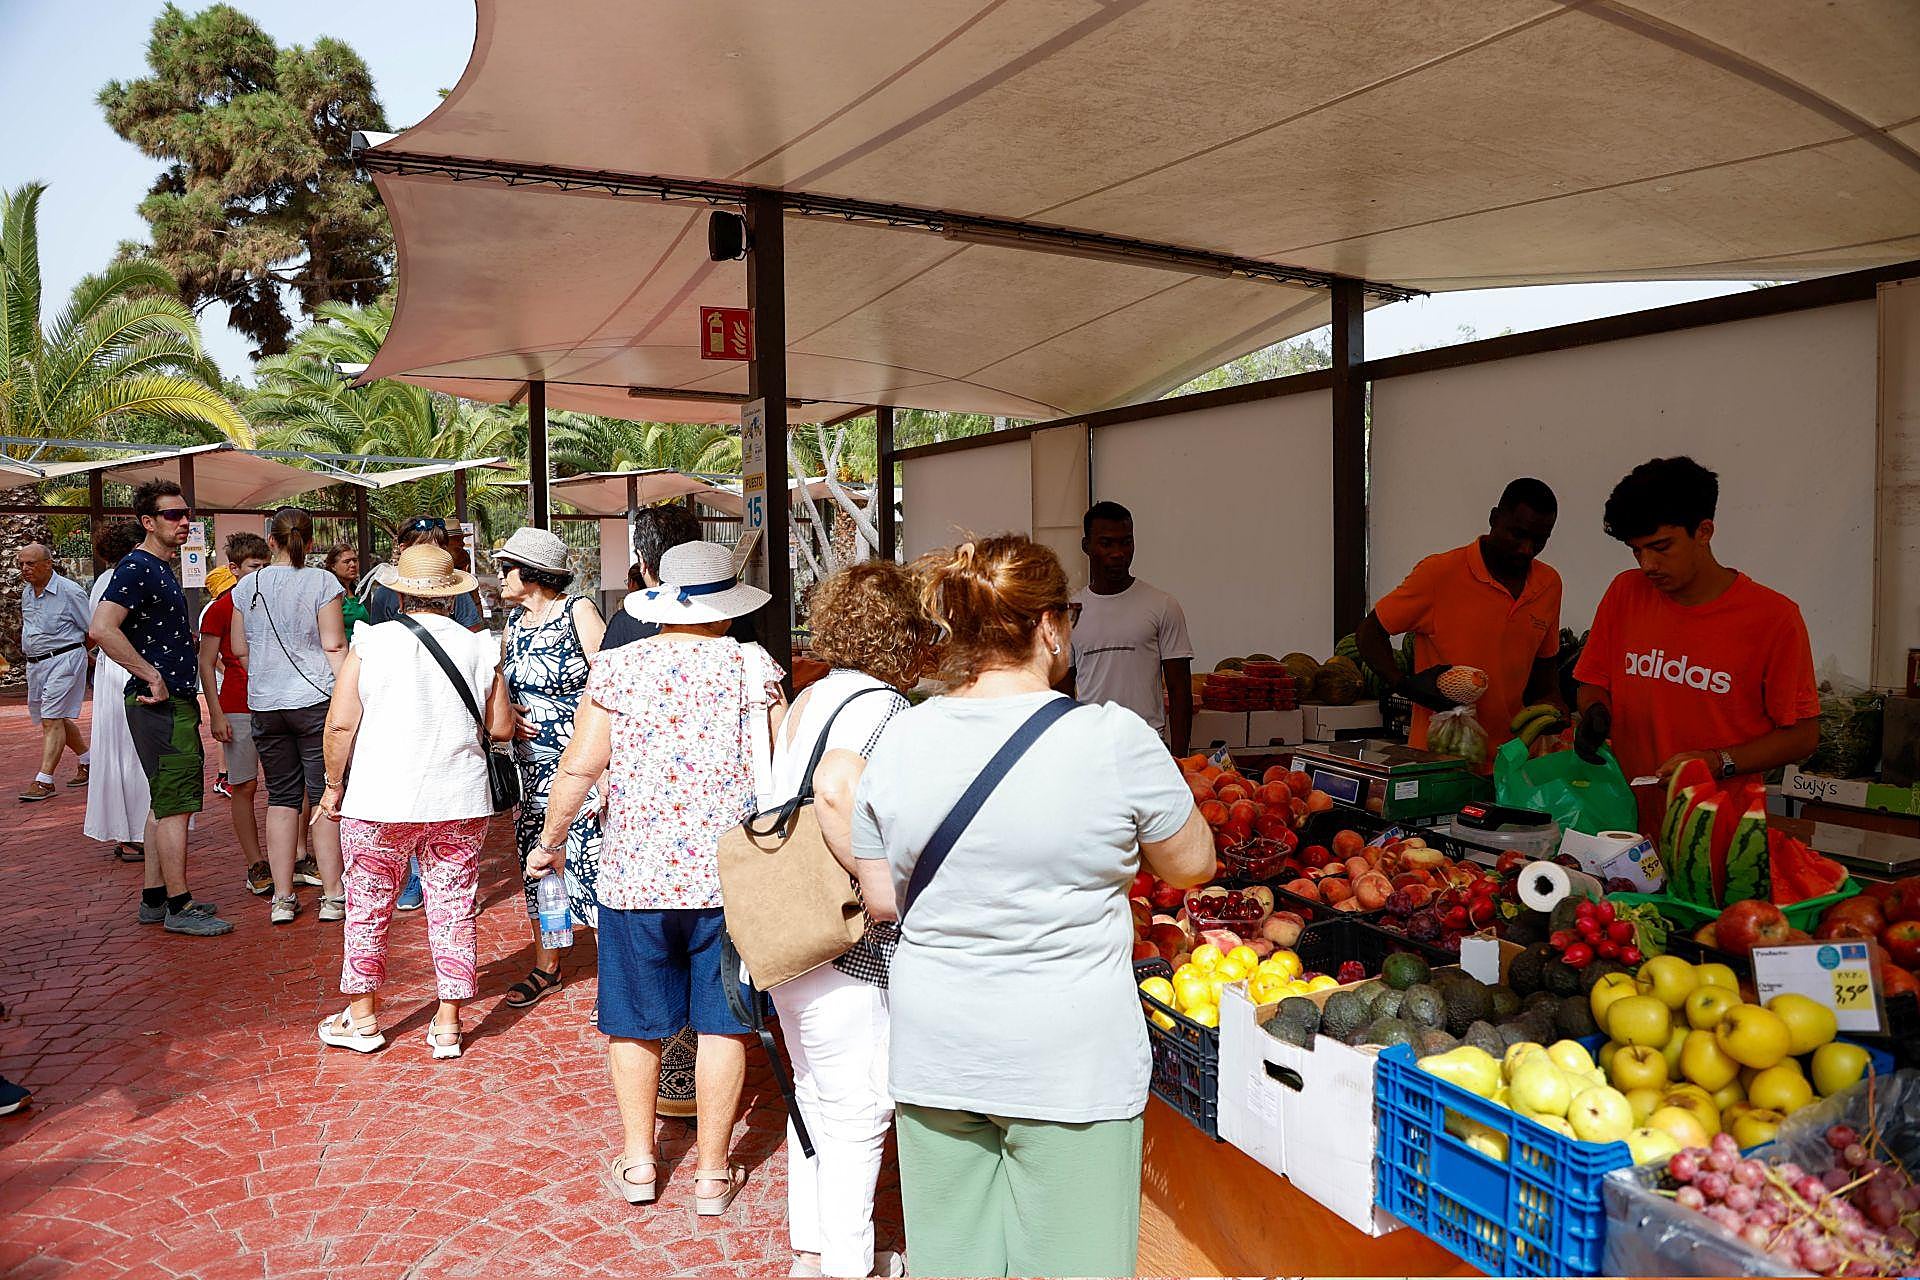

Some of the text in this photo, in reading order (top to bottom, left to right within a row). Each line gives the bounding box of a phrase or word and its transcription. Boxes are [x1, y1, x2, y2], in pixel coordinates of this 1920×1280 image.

[745, 476, 763, 489] PUESTO
[747, 496, 762, 528] 15
[189, 553, 198, 563] 9
[1625, 649, 1732, 694] adidas
[1793, 775, 1838, 797] Sujy's
[1835, 984, 1868, 1005] 3,50
